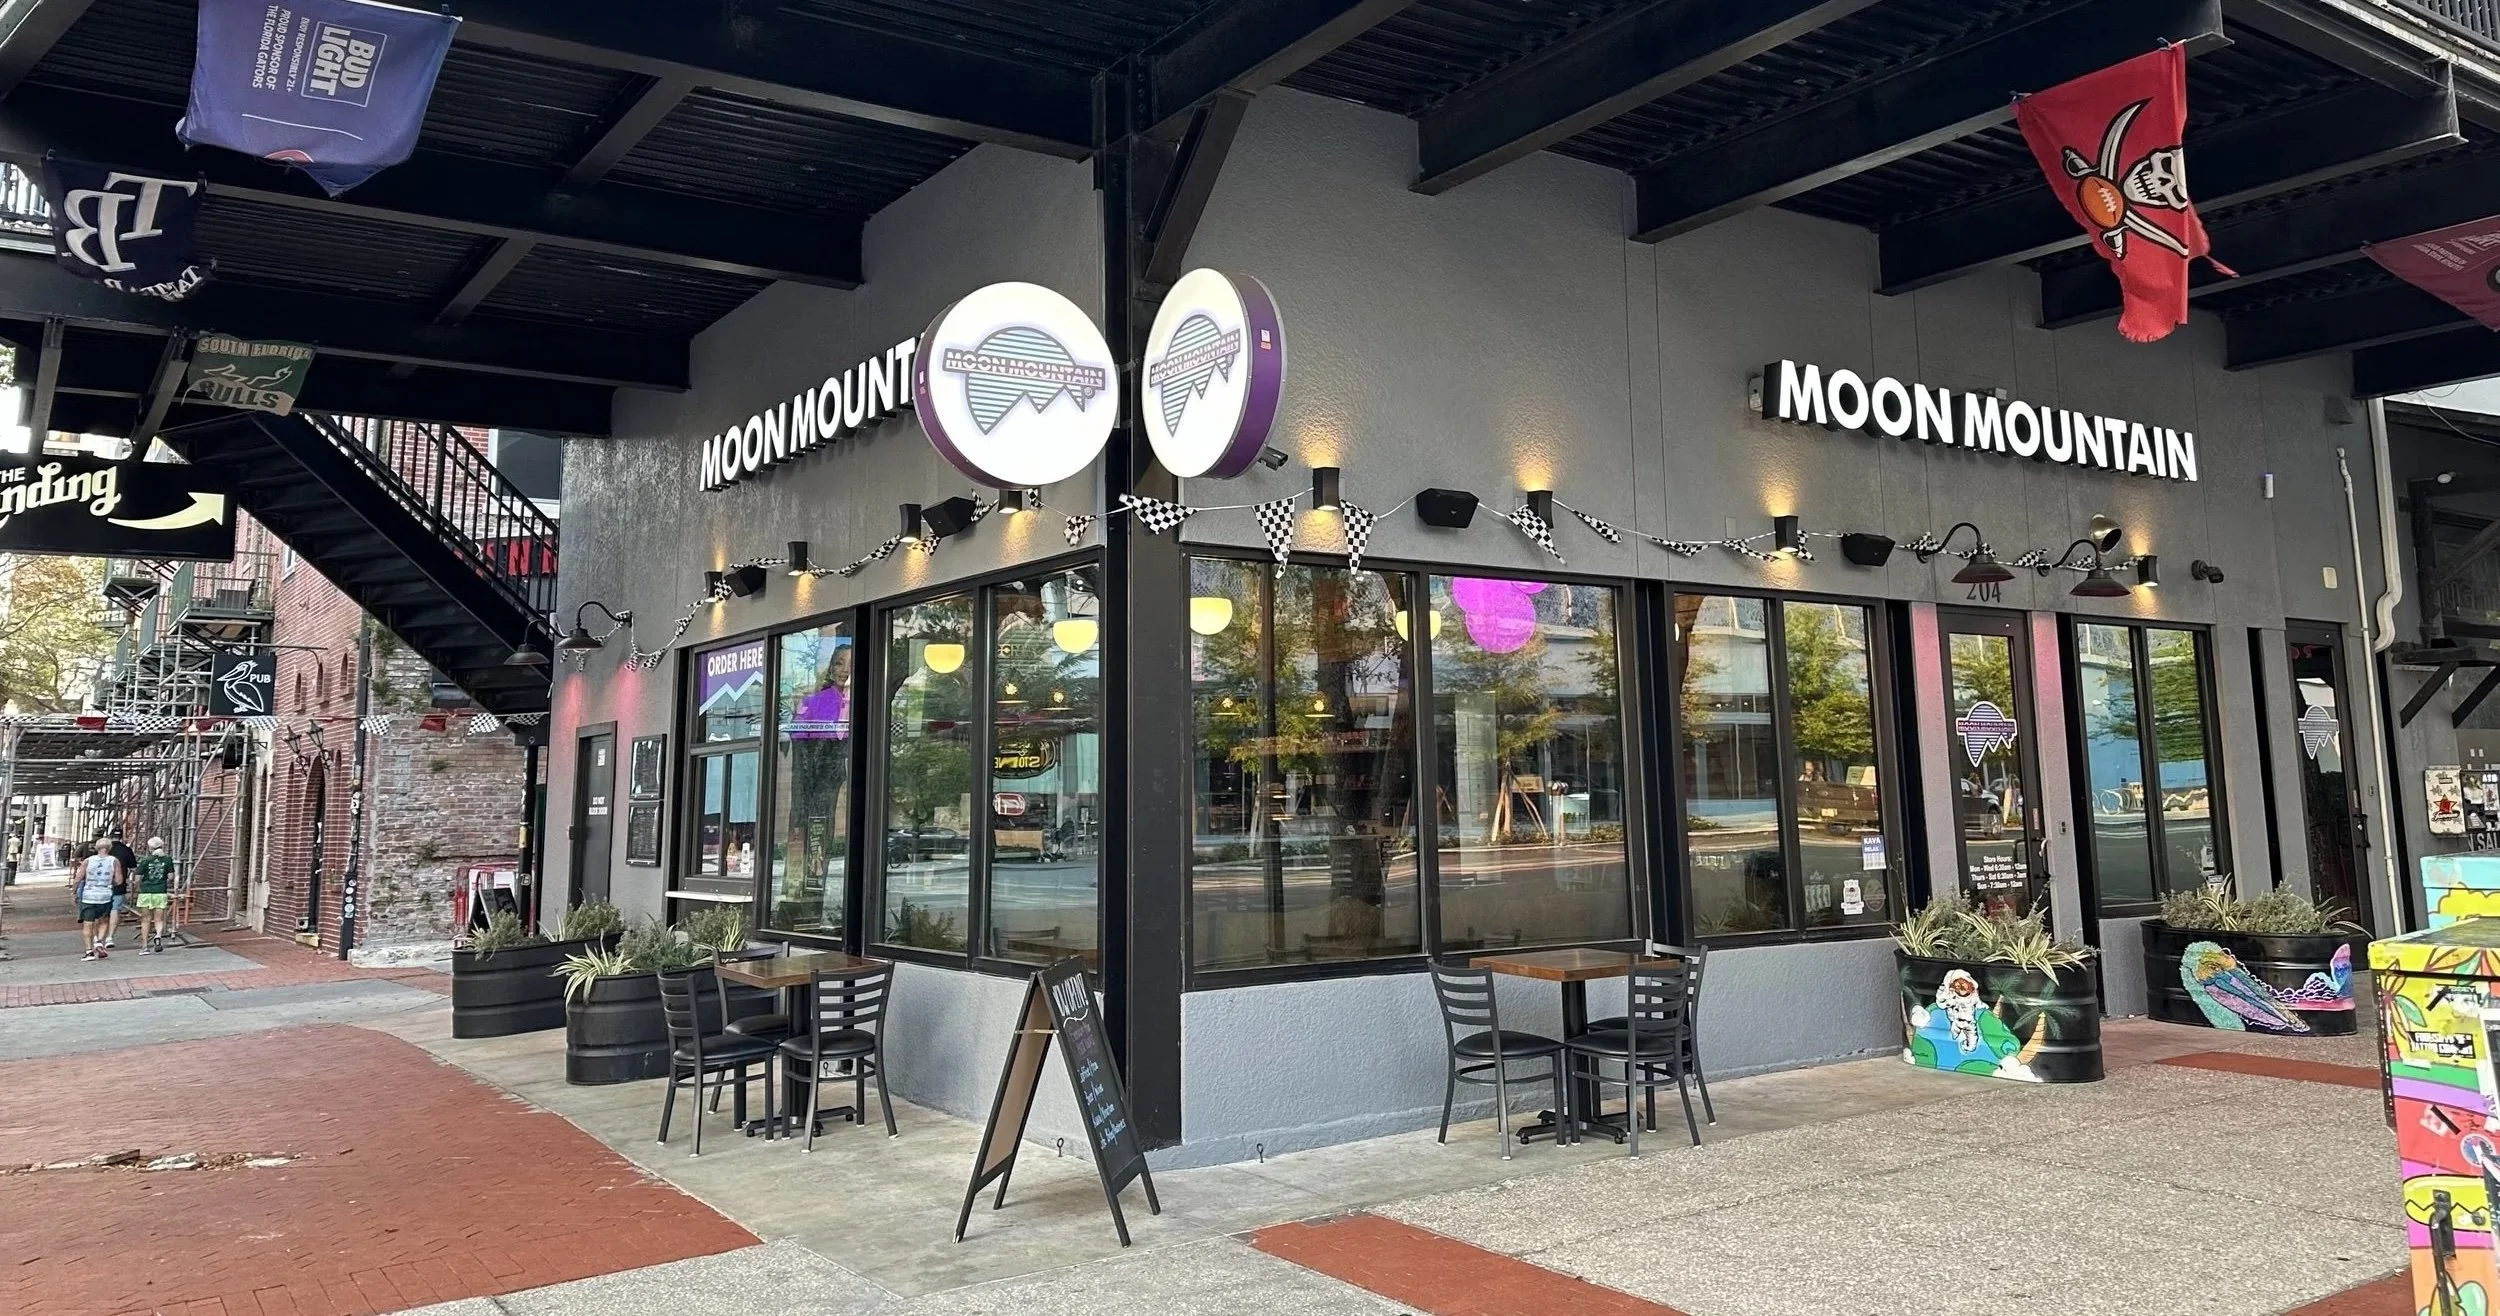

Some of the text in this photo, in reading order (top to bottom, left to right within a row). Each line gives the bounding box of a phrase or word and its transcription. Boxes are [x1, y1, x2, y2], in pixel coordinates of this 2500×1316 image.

[252, 5, 278, 89] THE FLORIDA GATORS
[265, 8, 291, 91] PROUD SPONSOR OF
[288, 33, 306, 79] RESPONSIBLY
[310, 26, 351, 96] LIGHT
[340, 39, 376, 88] BUD
[198, 337, 250, 357] SOUTH
[946, 350, 1103, 388] MOON MOUNTAIN
[199, 380, 279, 409] BULLS
[699, 336, 916, 492] MOON MOUNT
[1778, 359, 2198, 482] MOON MOUNTAIN
[0, 467, 26, 484] HE
[0, 461, 122, 517] nding
[1966, 582, 2001, 604] 204
[88, 610, 126, 623] HOTEL
[249, 673, 271, 684] PUB
[707, 646, 764, 677] ORDER HERE
